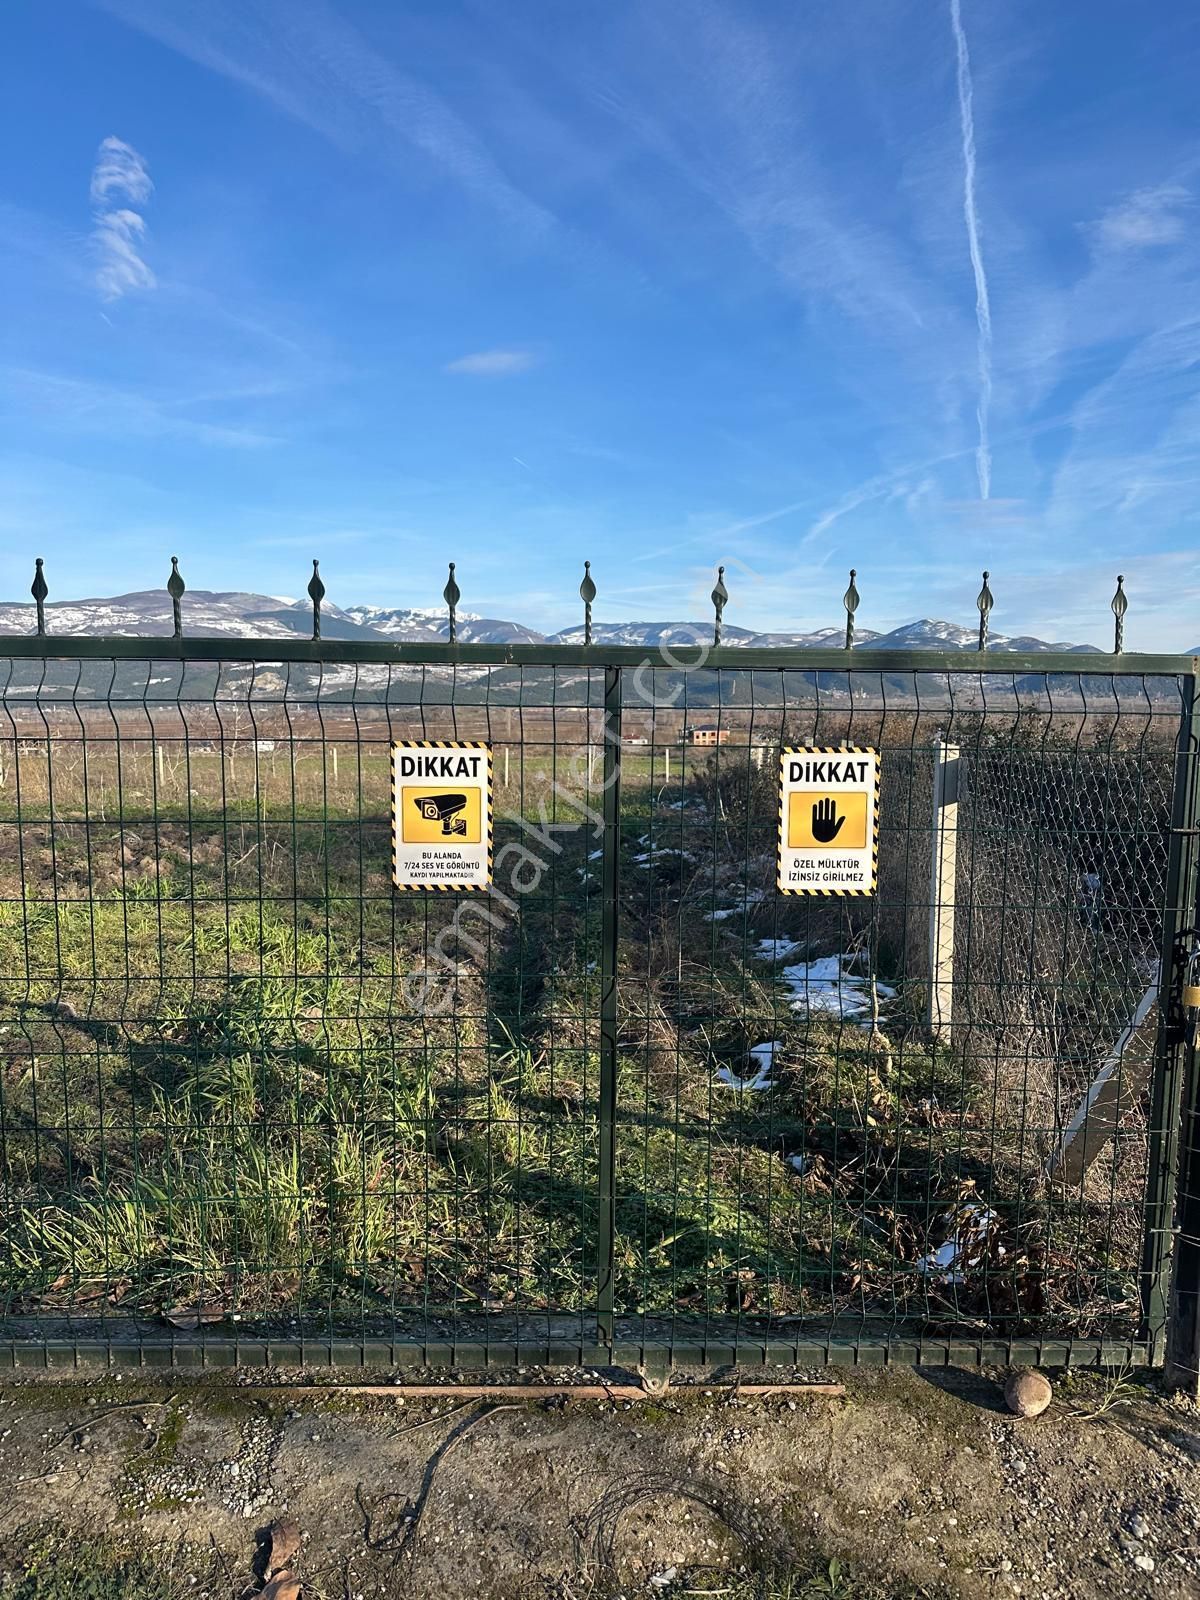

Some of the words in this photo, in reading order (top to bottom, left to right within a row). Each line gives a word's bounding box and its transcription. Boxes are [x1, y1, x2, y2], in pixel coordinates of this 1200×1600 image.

[422, 852, 432, 860] BU
[433, 852, 462, 860] ALANDA
[404, 862, 420, 870] 7/24
[421, 862, 434, 870] SES
[435, 862, 445, 870] VE
[446, 861, 480, 870] GÖRÜNTÜ
[793, 858, 816, 869] ÖZEL
[818, 858, 860, 869] MÜLKTÜR
[789, 871, 820, 882] İZİNSİZ
[822, 871, 864, 882] GİRİLMEZ
